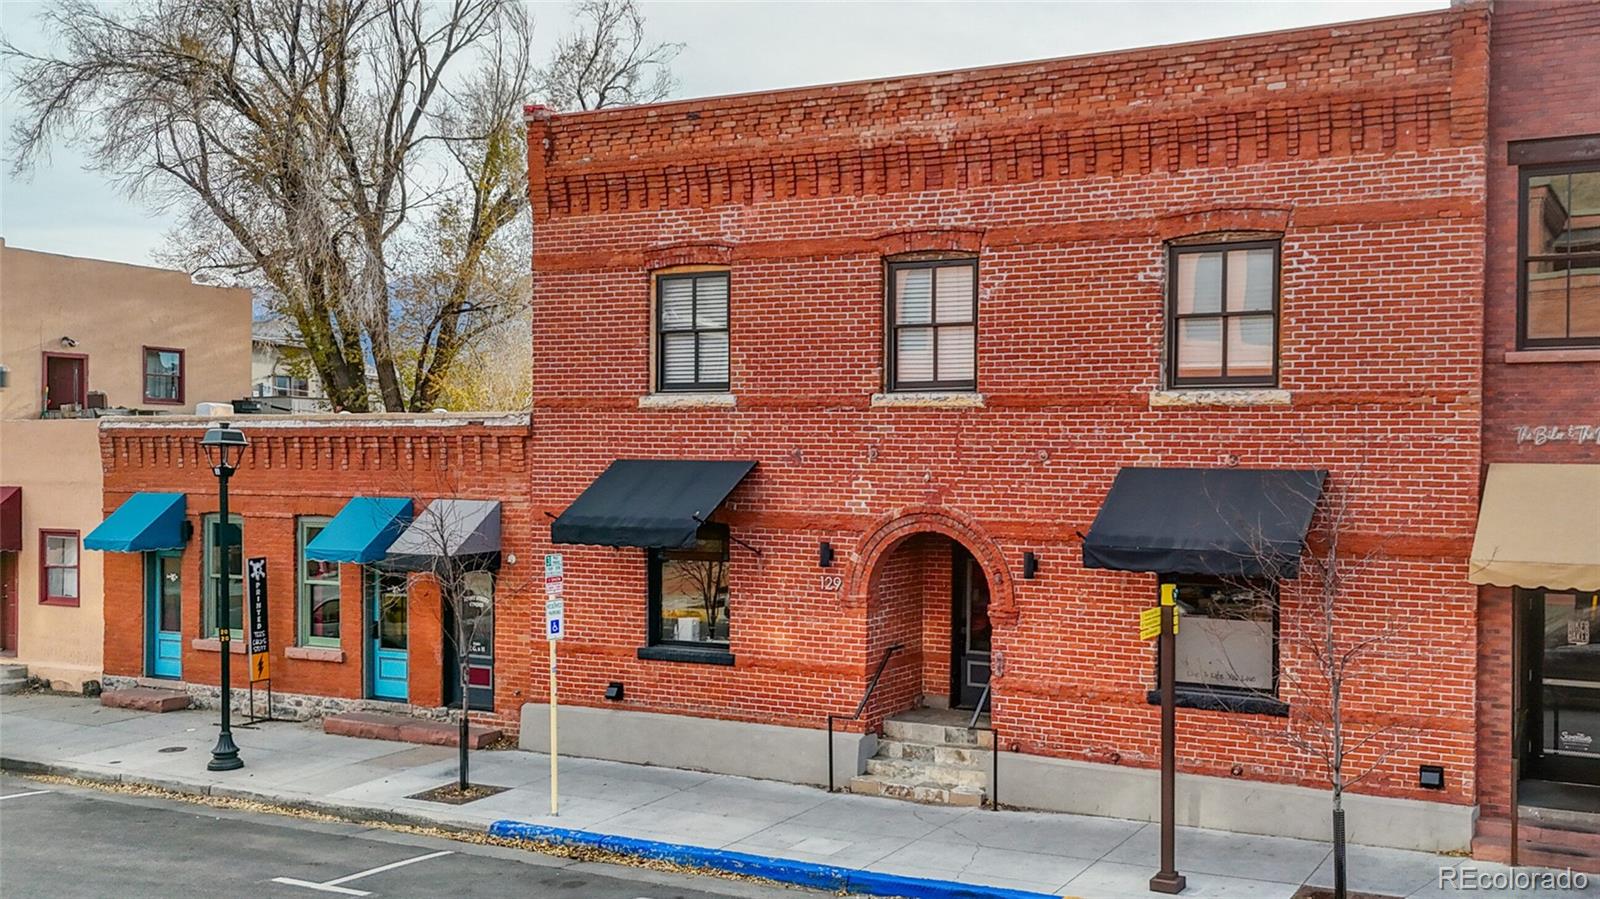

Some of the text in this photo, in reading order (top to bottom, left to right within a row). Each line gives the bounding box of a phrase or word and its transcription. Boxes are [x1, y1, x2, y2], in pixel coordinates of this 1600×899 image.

[1512, 425, 1533, 444] The
[1575, 425, 1595, 445] The
[820, 576, 842, 590] 129
